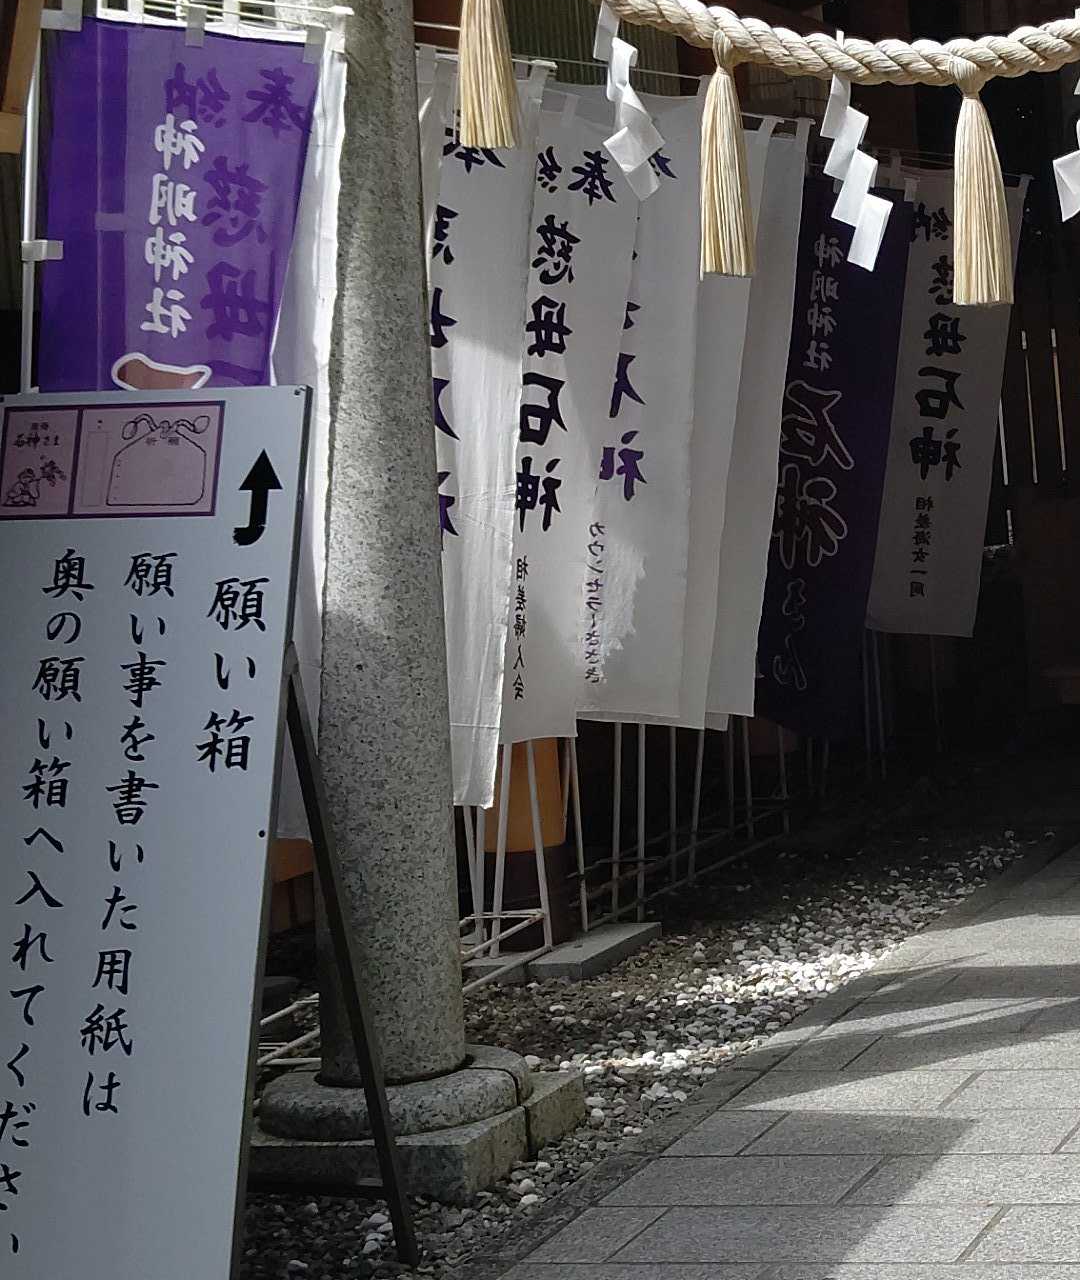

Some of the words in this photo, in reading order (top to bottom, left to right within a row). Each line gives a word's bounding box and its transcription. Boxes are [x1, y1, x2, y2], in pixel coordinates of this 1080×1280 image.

[80, 551, 178, 1117] 願い事を書いた用紙は
[195, 576, 269, 773] 願い箱
